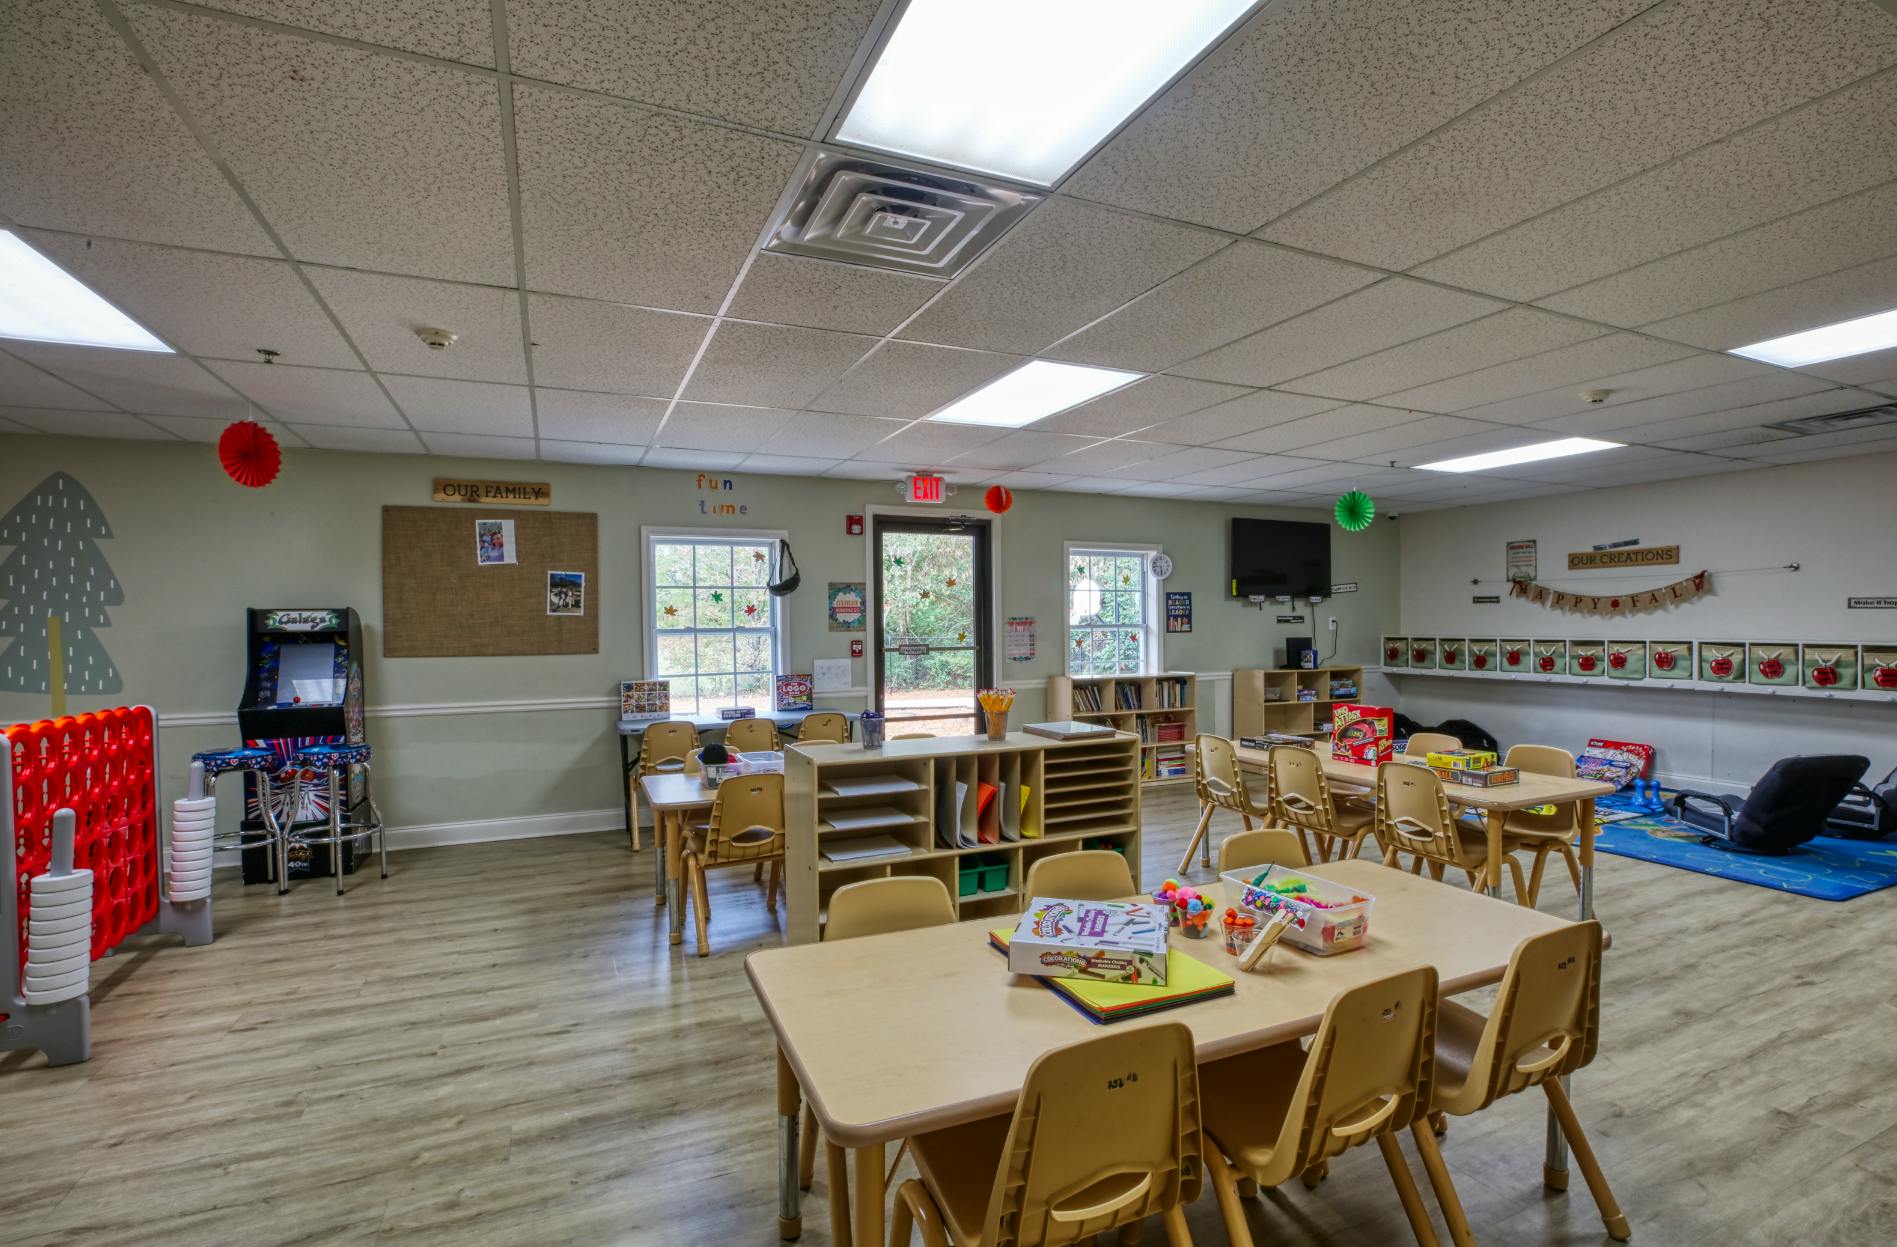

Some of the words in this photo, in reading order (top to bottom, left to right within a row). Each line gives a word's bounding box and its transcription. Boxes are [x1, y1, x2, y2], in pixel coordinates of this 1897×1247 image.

[696, 473, 733, 490] fun
[912, 476, 941, 501] EXIT
[443, 483, 480, 497] OUR
[485, 485, 543, 500] FAMILY
[698, 499, 748, 515] time
[1569, 552, 1597, 566] OUR
[1600, 549, 1673, 565] CREATIONS
[1519, 583, 1600, 610] HAPPY
